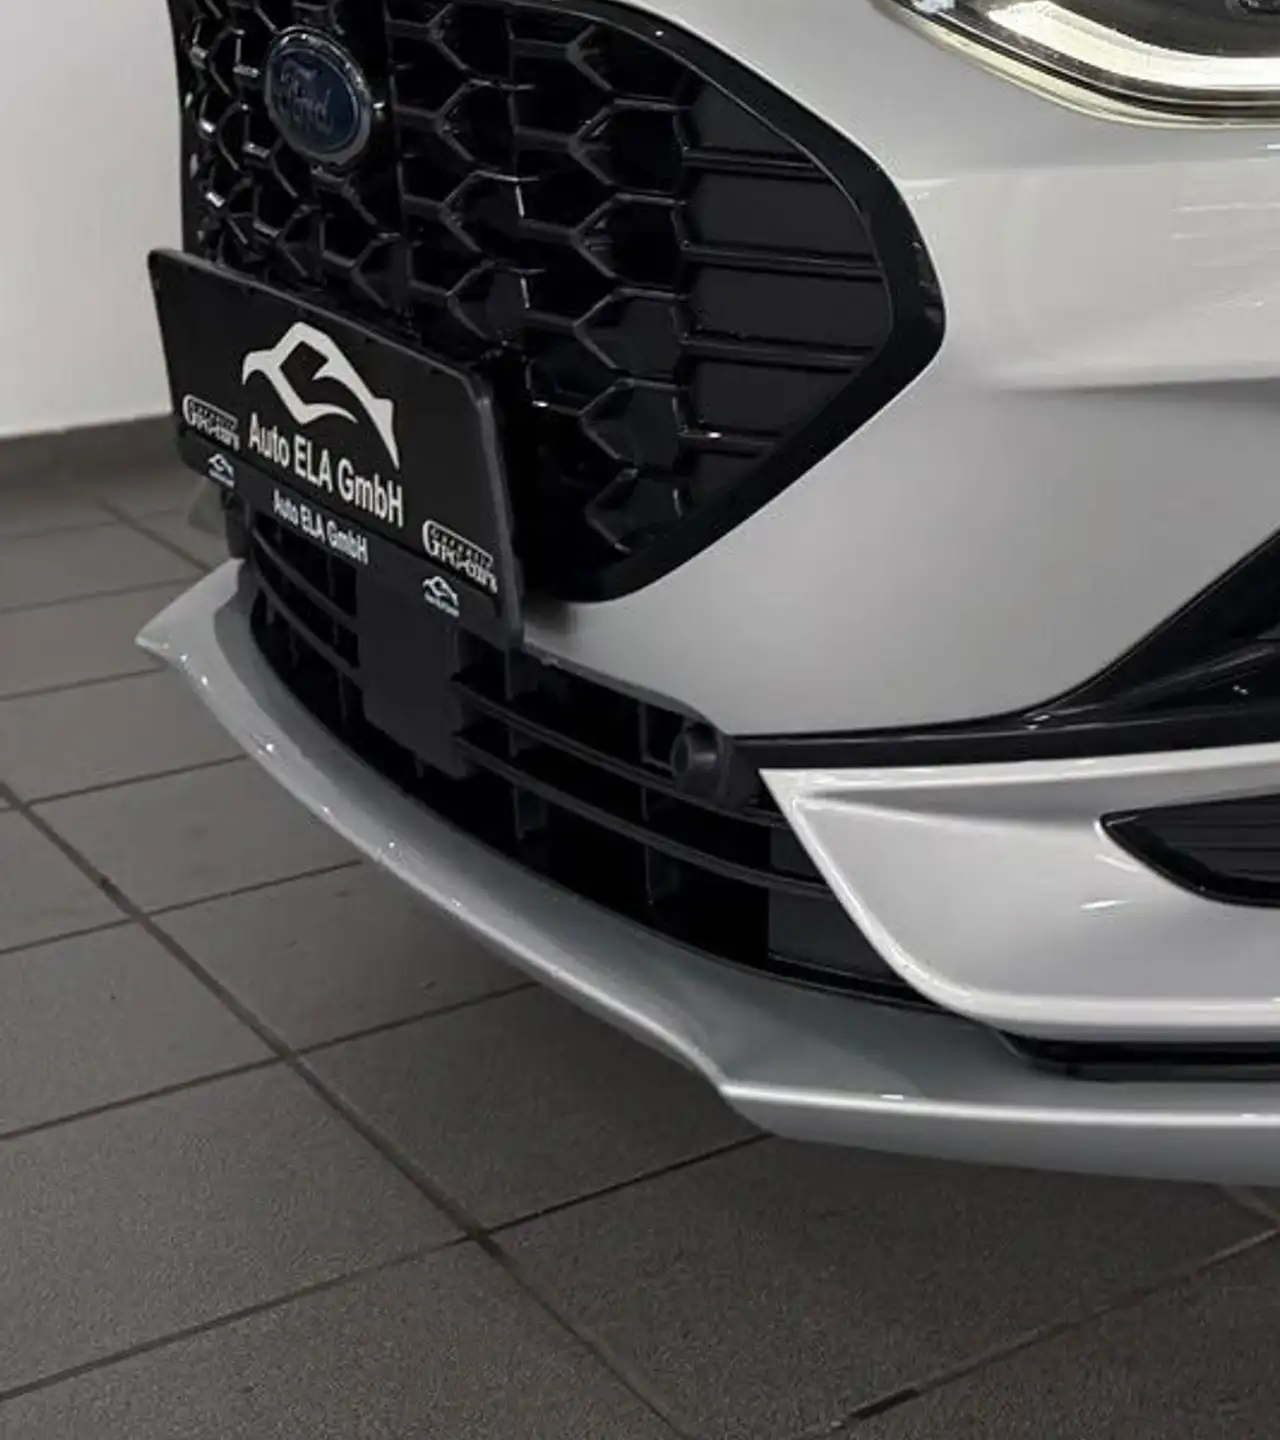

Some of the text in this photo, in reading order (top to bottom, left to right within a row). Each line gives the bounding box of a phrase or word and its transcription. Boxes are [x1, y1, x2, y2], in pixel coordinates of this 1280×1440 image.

[249, 412, 290, 468] Auto
[294, 434, 333, 493] ELA
[338, 458, 403, 528] GmbH
[273, 488, 368, 565] Auto ELA GmbH
